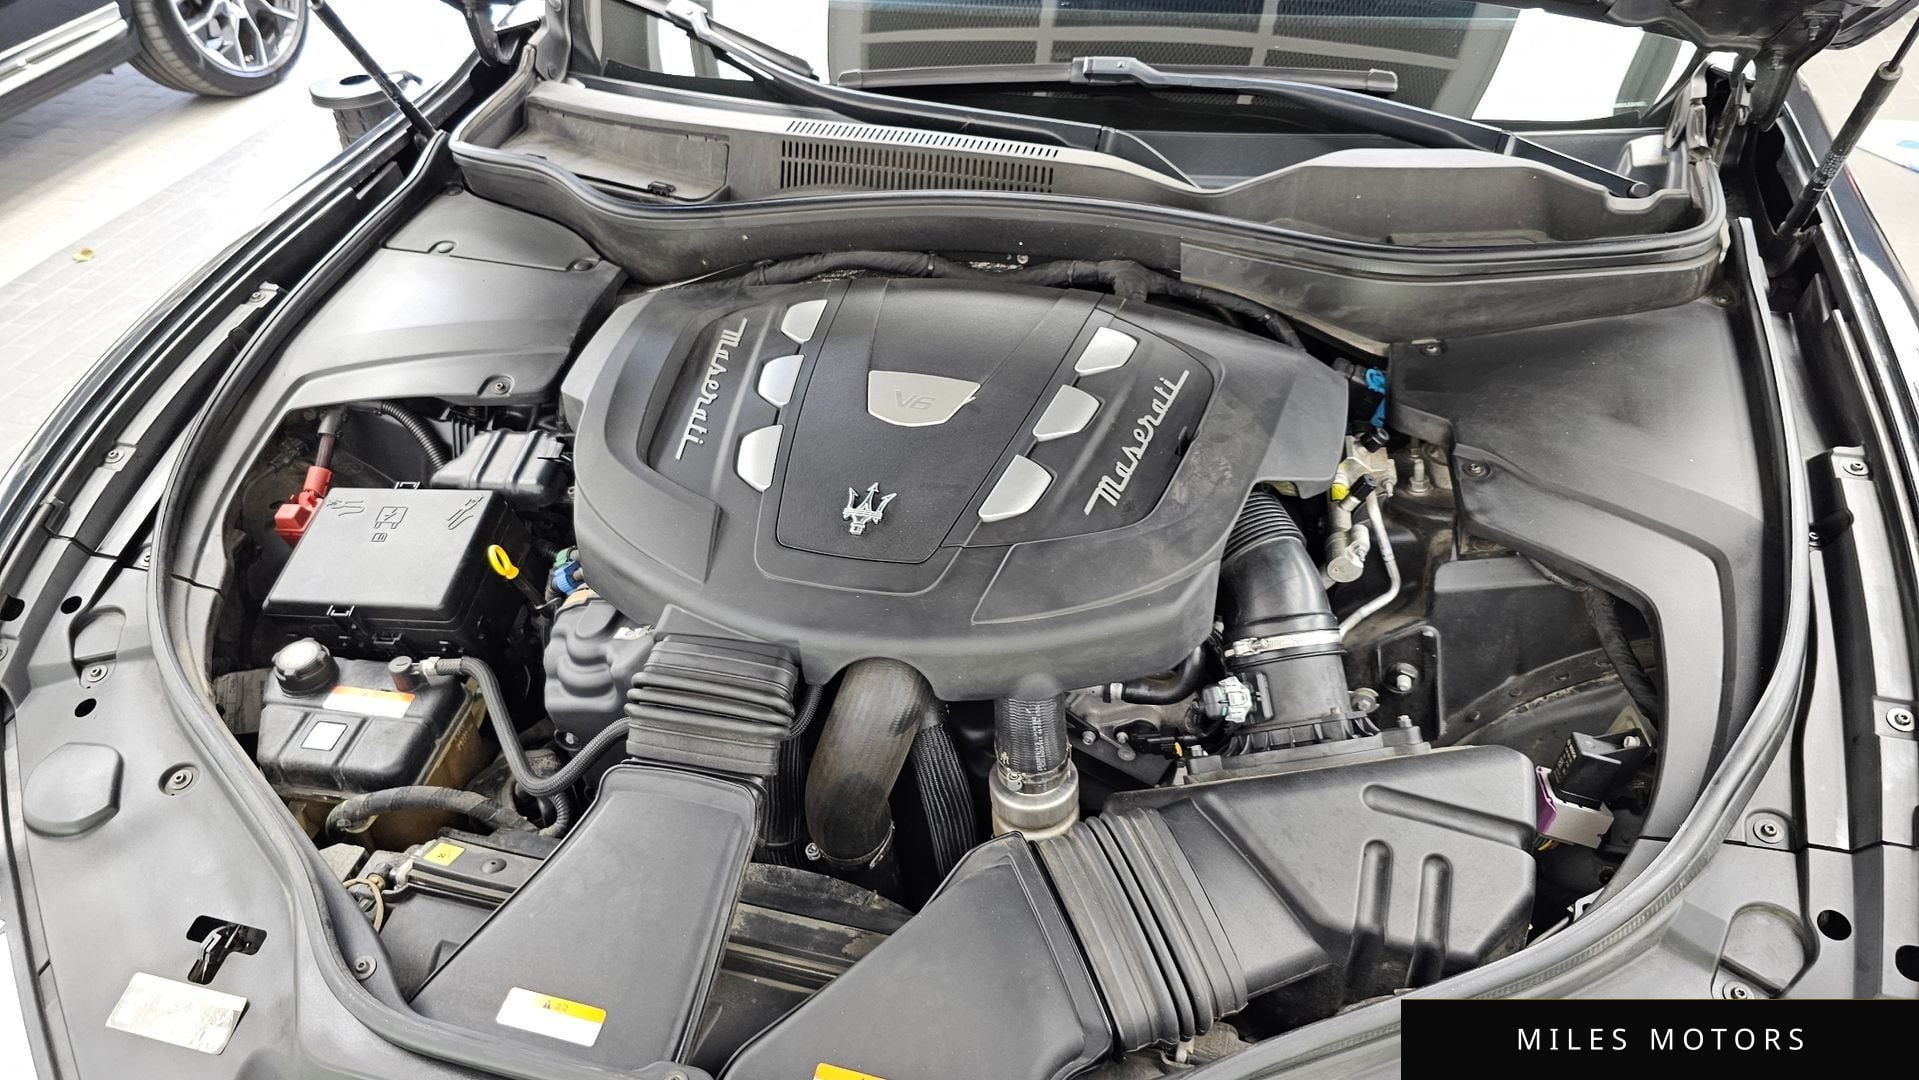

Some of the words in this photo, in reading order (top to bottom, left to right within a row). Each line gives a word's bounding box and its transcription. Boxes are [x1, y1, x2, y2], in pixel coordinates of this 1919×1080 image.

[675, 317, 748, 460] Maserati
[894, 390, 937, 411] V6
[1084, 369, 1190, 515] Maserati
